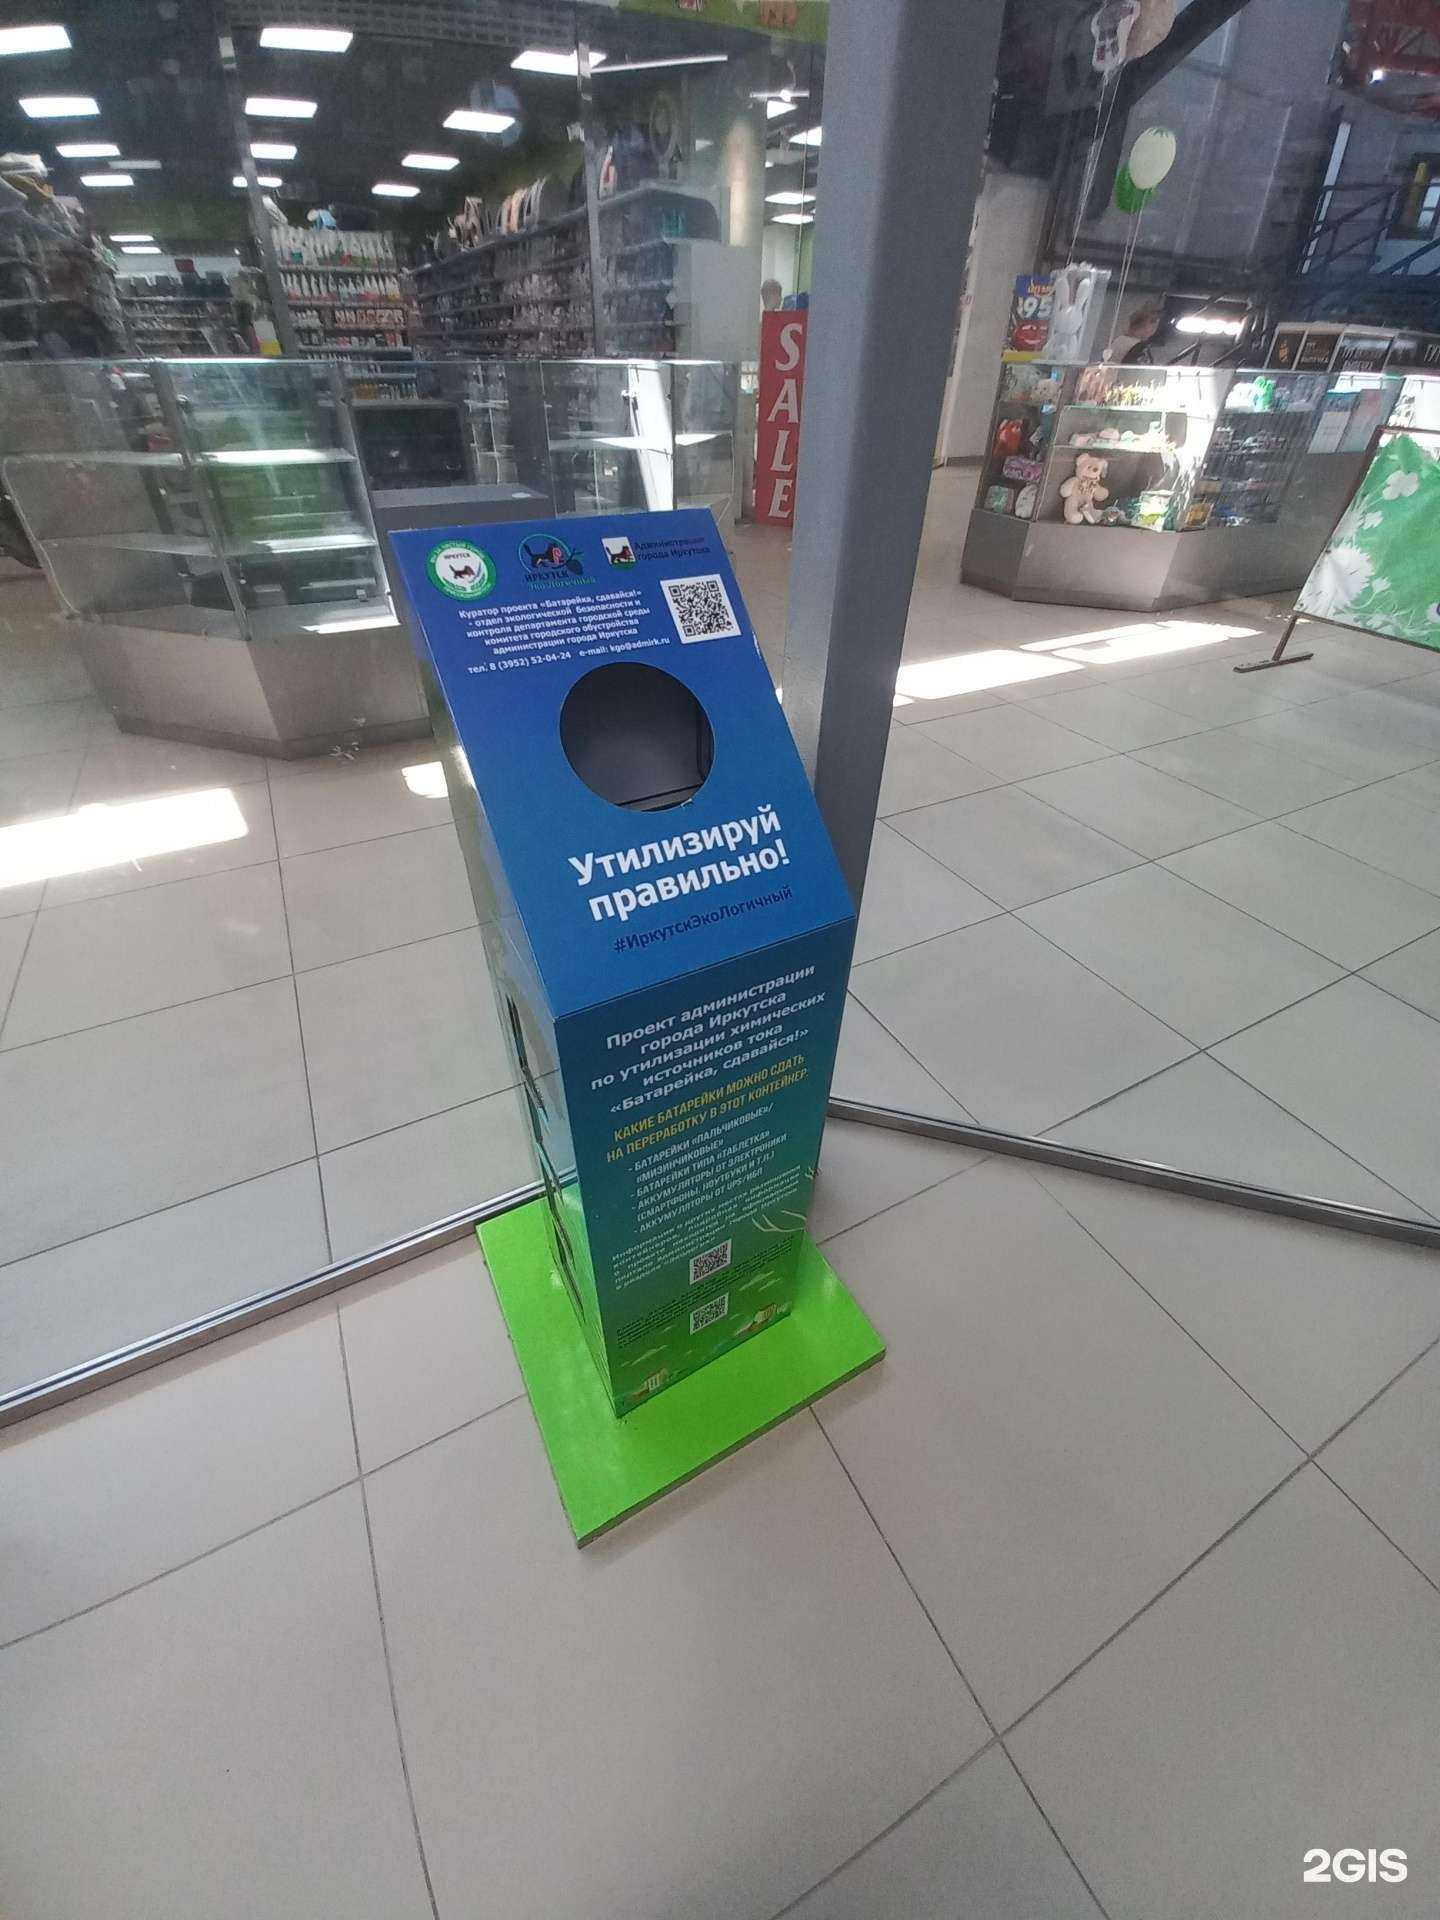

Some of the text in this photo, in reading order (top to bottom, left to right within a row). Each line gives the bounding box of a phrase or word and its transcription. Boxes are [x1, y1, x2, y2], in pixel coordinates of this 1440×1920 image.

[767, 323, 802, 518] SALE
[459, 607, 499, 620] Куратор
[501, 603, 538, 615] проекта
[467, 607, 650, 638] контроля департамента городской среды
[475, 617, 502, 627] отдел
[505, 607, 572, 623] экологической
[576, 600, 634, 614] безопасности
[484, 619, 639, 646] комитета городского обустройства
[493, 628, 638, 655] администрации города Иркутска
[489, 662, 497, 671] 8
[498, 657, 529, 671] (3952)
[531, 651, 571, 665] 52-04-24
[579, 646, 608, 657] e-mail:
[609, 638, 670, 653] kgo@admirk.ru
[568, 804, 782, 886] Утилизируй
[589, 838, 791, 922] правильно!
[613, 885, 793, 953] #ИркутскЭкоЛогичный
[606, 966, 815, 1050] Проект администрации
[641, 992, 786, 1054] города Иркутска
[591, 992, 826, 1091] по утилизации химических
[610, 1028, 809, 1113] «Батарейка, сдавайся!»
[643, 1025, 783, 1087] источников тока
[607, 1147, 624, 1163] НА
[626, 1111, 707, 1154] ПЕРЕРАБОТКУ
[710, 1107, 718, 1119] В
[720, 1095, 746, 1114] ЭТОТ
[614, 1055, 805, 1142] КАКИЕ БАТАРЕЙКИ МОЖНО СДАТЬ
[635, 1140, 690, 1171] БАТАРЕЙКИ
[637, 1166, 690, 1197] БАТАРЕЙКИ
[692, 1155, 715, 1171] ТИПА
[638, 1167, 714, 1210] АККУМУЛЯТОРЫ
[715, 1162, 728, 1173] ОТ
[728, 1133, 787, 1167] ЭЛЕКТРОНИКИ
[703, 1164, 747, 1191] НОУТБУКИ
[640, 1190, 714, 1233] АККУМУЛЯТОРЫ
[715, 1186, 726, 1196] ОТ
